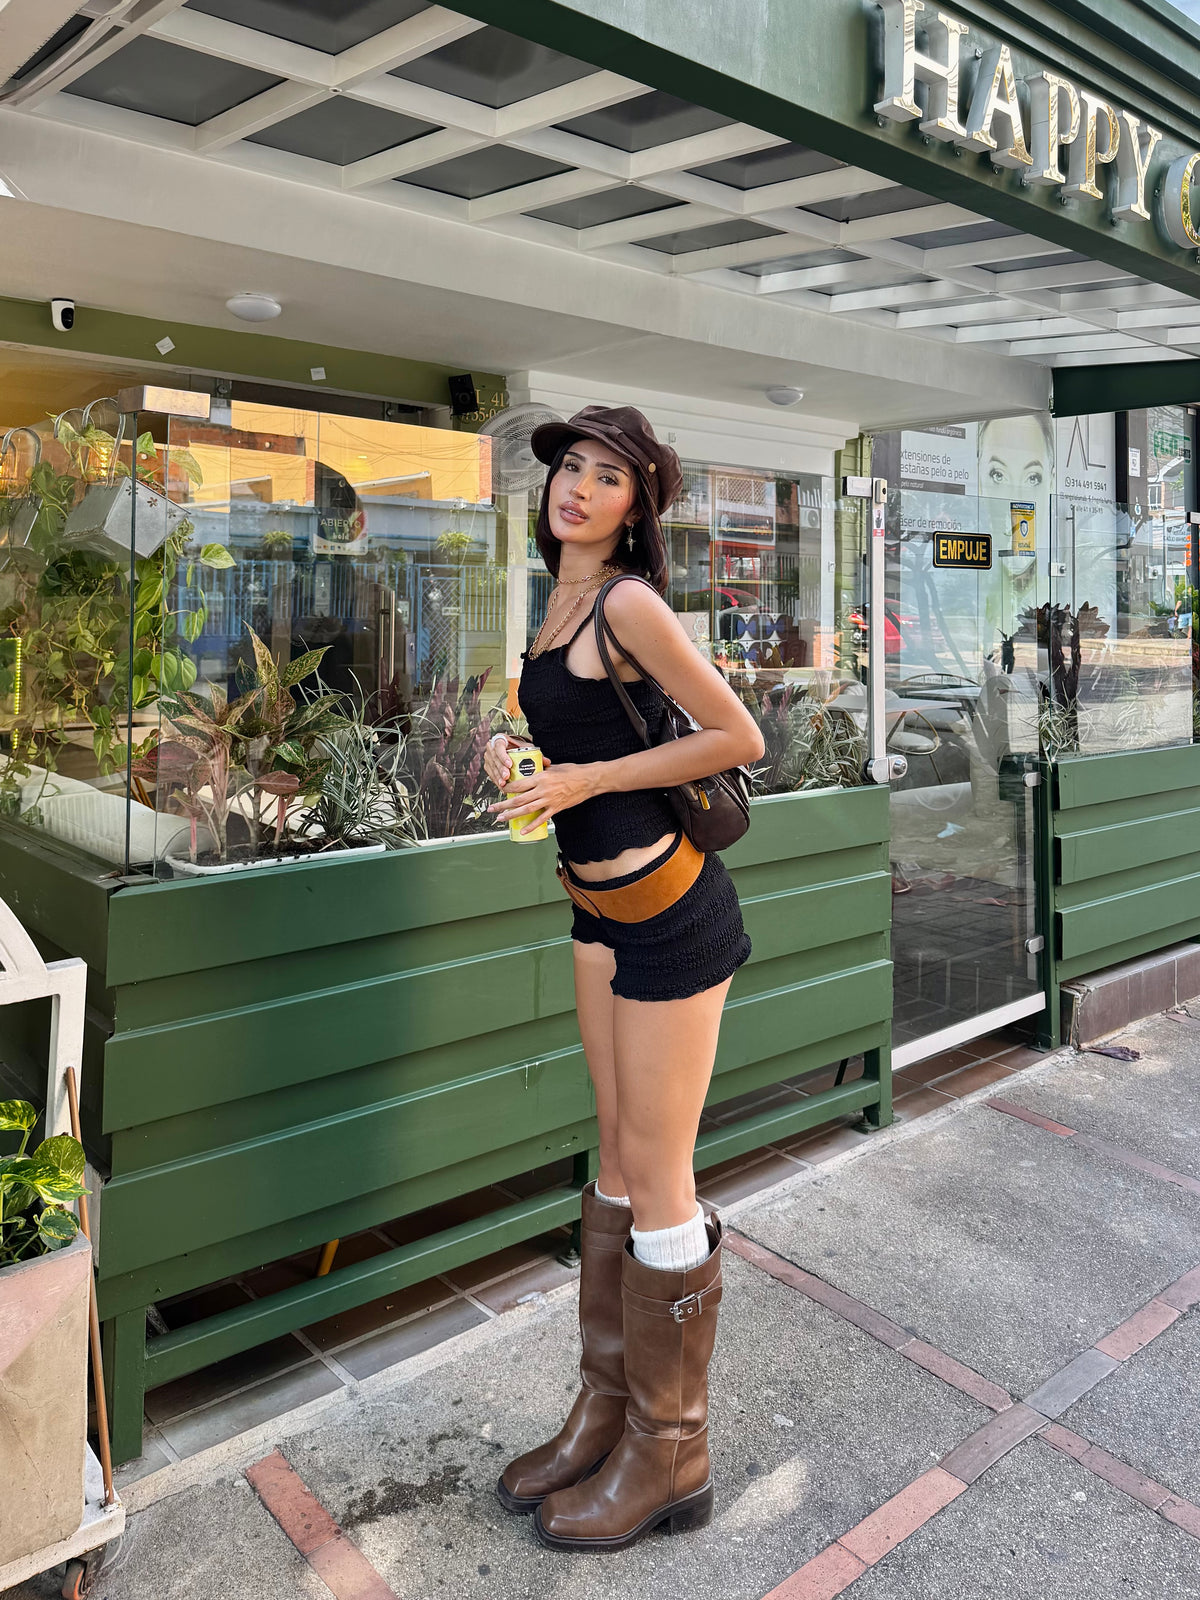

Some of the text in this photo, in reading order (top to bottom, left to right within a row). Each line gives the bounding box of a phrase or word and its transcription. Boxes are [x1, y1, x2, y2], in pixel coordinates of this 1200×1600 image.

[876, 0, 1162, 221] HAPPY
[491, 392, 505, 407] 41
[941, 453, 951, 465] de
[900, 462, 970, 480] estañas pelo a pelo
[1071, 478, 1107, 492] 314 491 5941
[320, 518, 361, 529] ABIERTO
[917, 516, 927, 528] de
[939, 539, 987, 561] EMPUJE
